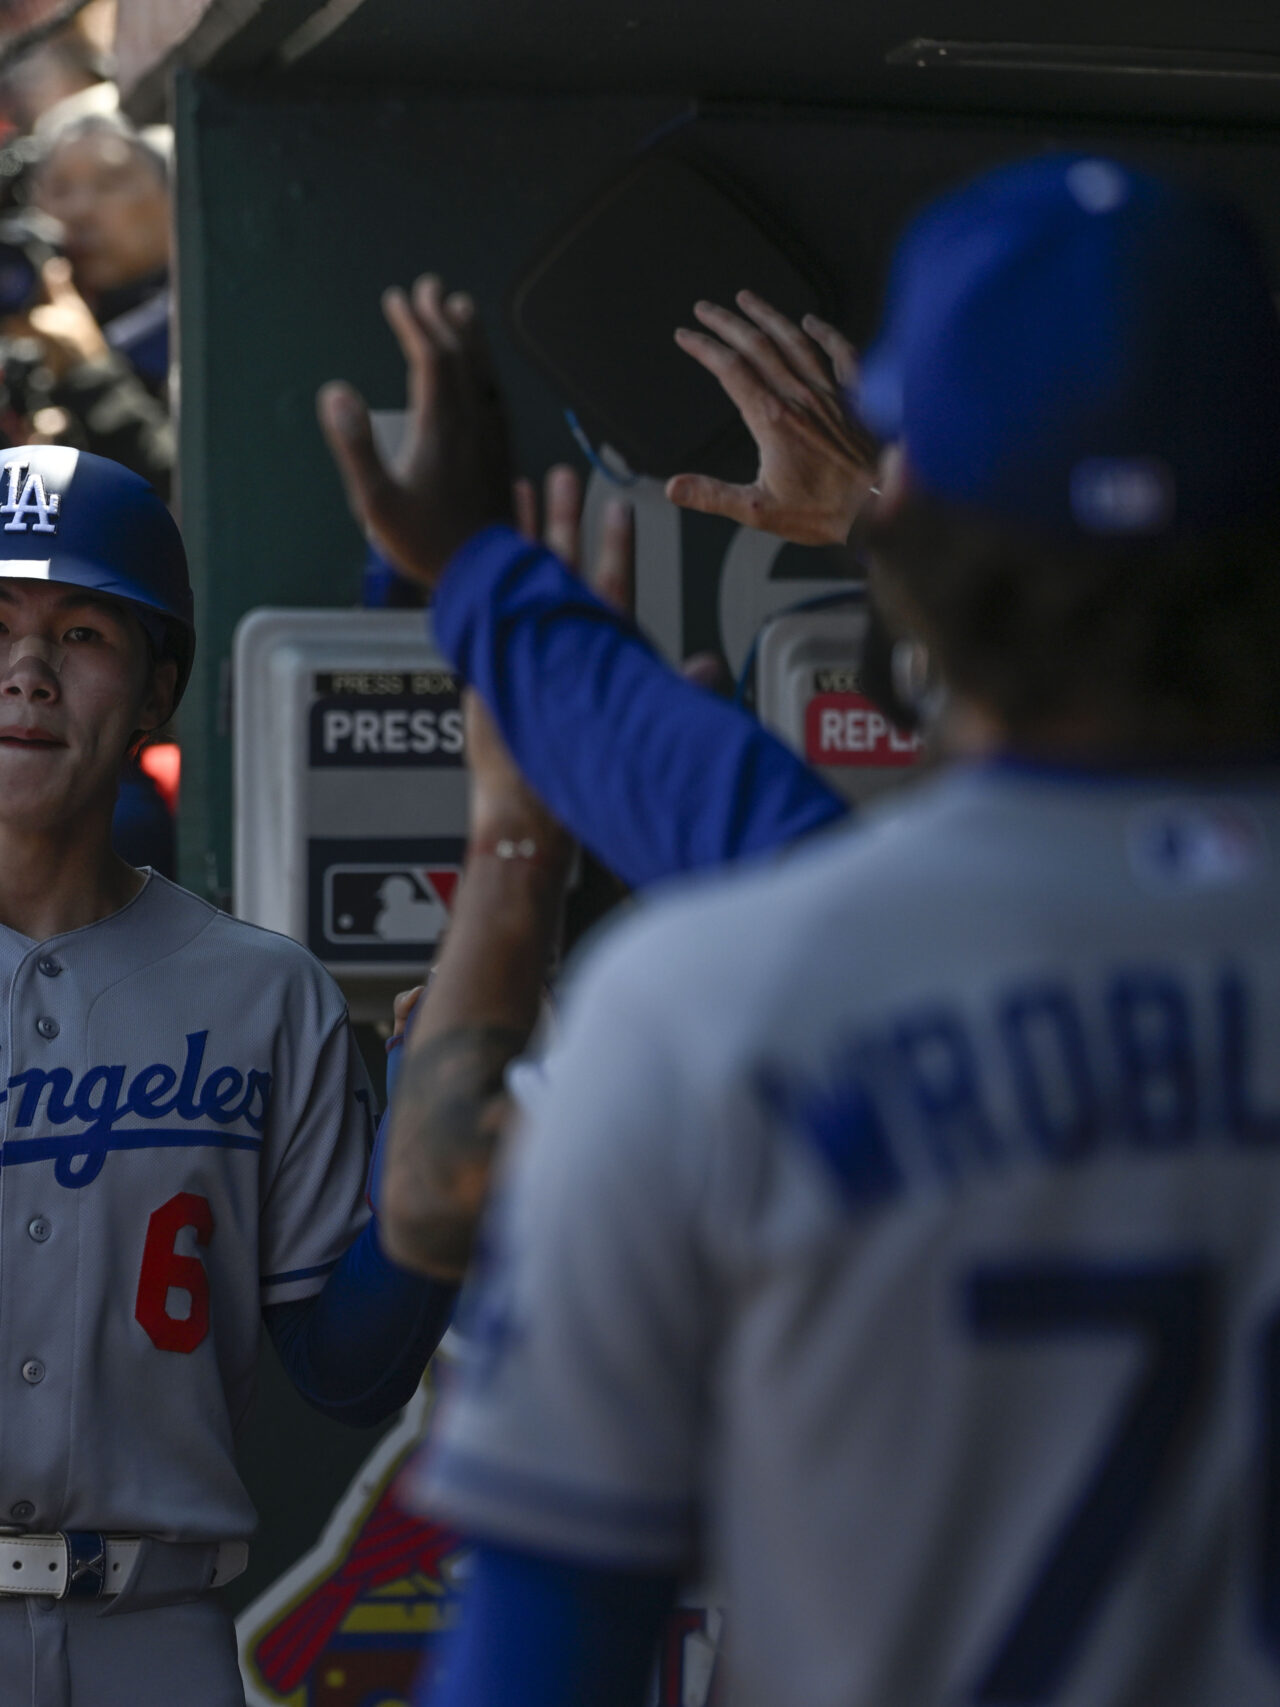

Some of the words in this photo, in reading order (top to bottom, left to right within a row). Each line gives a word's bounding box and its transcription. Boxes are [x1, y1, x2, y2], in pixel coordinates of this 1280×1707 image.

[0, 461, 60, 533] LA
[331, 672, 404, 695] PRESS
[411, 672, 456, 695] BOX
[322, 708, 465, 754] PRESS
[134, 1190, 214, 1355] 6
